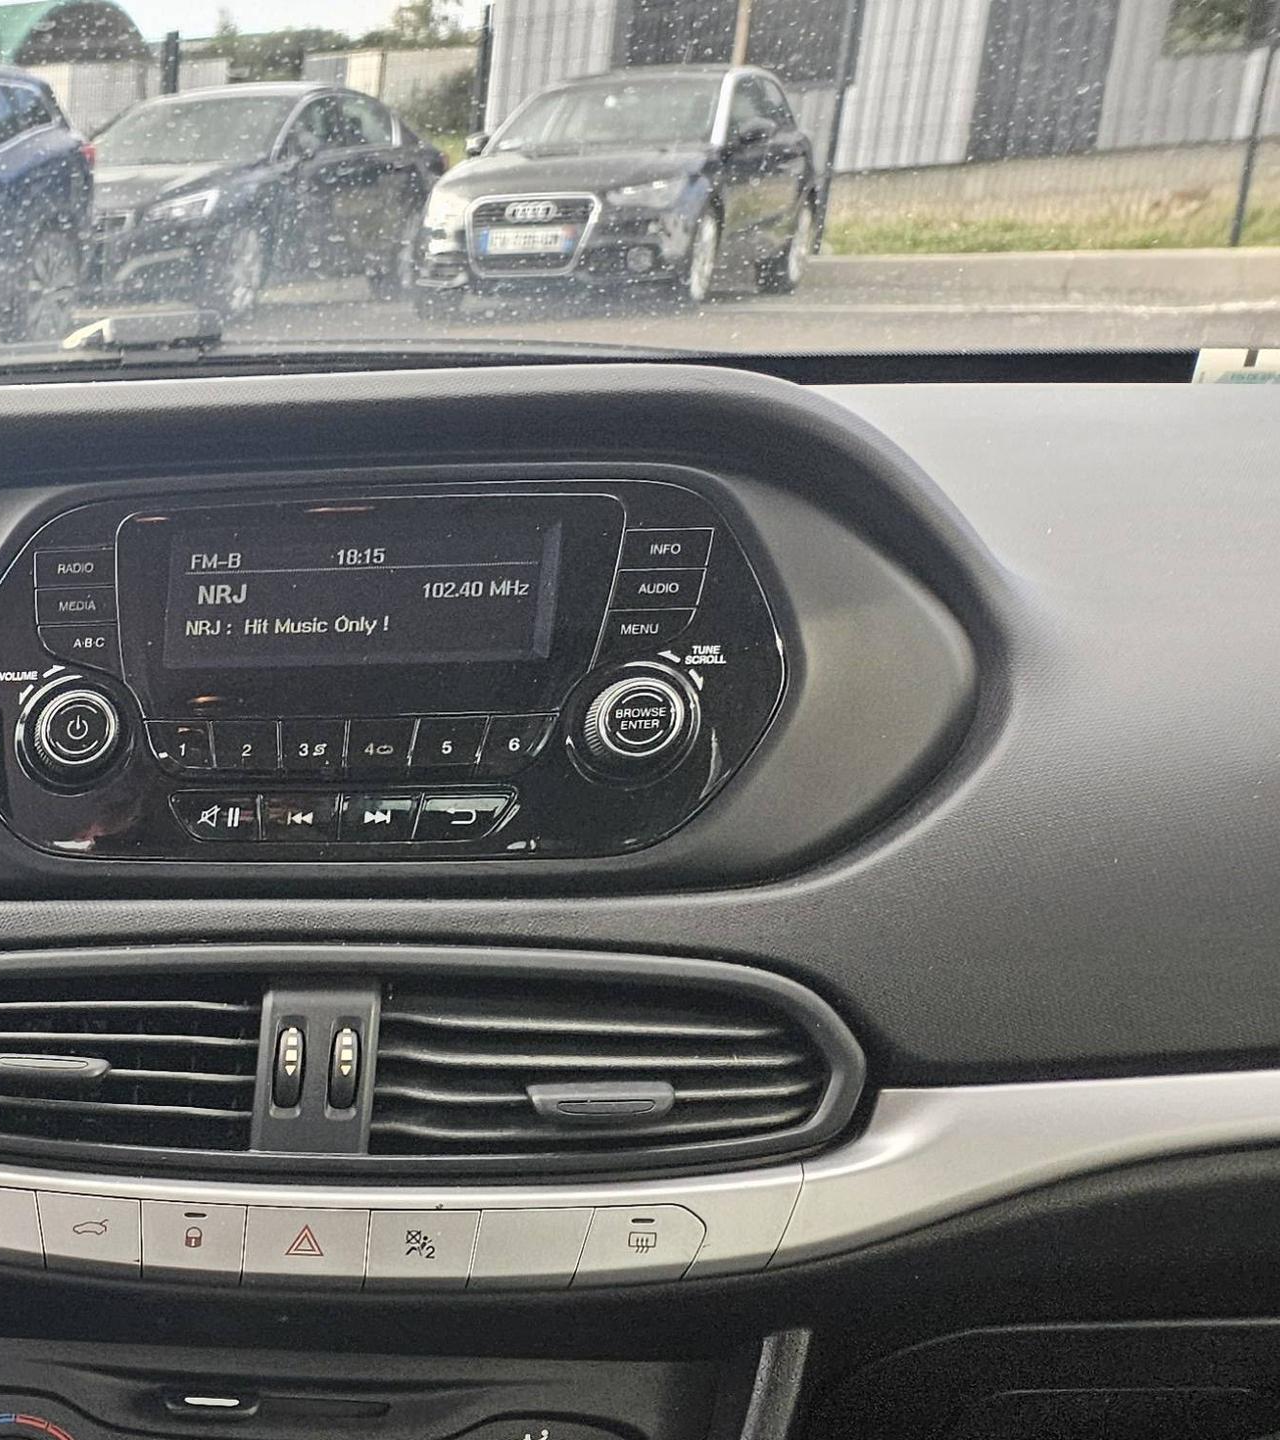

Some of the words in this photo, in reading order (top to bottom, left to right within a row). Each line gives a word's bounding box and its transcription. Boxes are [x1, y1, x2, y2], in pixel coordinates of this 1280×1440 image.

[650, 544, 681, 555] INFO
[336, 547, 386, 566] 18:15
[57, 562, 94, 575] RADIO
[197, 583, 248, 606] NRJ
[422, 581, 484, 599] 102.40
[489, 579, 530, 597] MHz
[638, 583, 680, 594] AUDIO
[59, 600, 96, 612] MEDIA
[185, 620, 221, 637] NRJ
[244, 620, 269, 635] Hit
[274, 616, 329, 634] Music
[334, 616, 377, 636] Only
[620, 624, 659, 635] MENU
[692, 645, 721, 655] TUNE
[684, 655, 727, 665] SCROLL
[0, 671, 38, 682] VOLUME
[615, 707, 667, 719] BROWSE
[620, 719, 660, 730] ENTER
[178, 743, 186, 757] 1
[241, 744, 252, 757] 2
[298, 743, 309, 757] 3
[364, 743, 375, 756] 4
[441, 741, 452, 754] 5
[508, 738, 521, 752] 6
